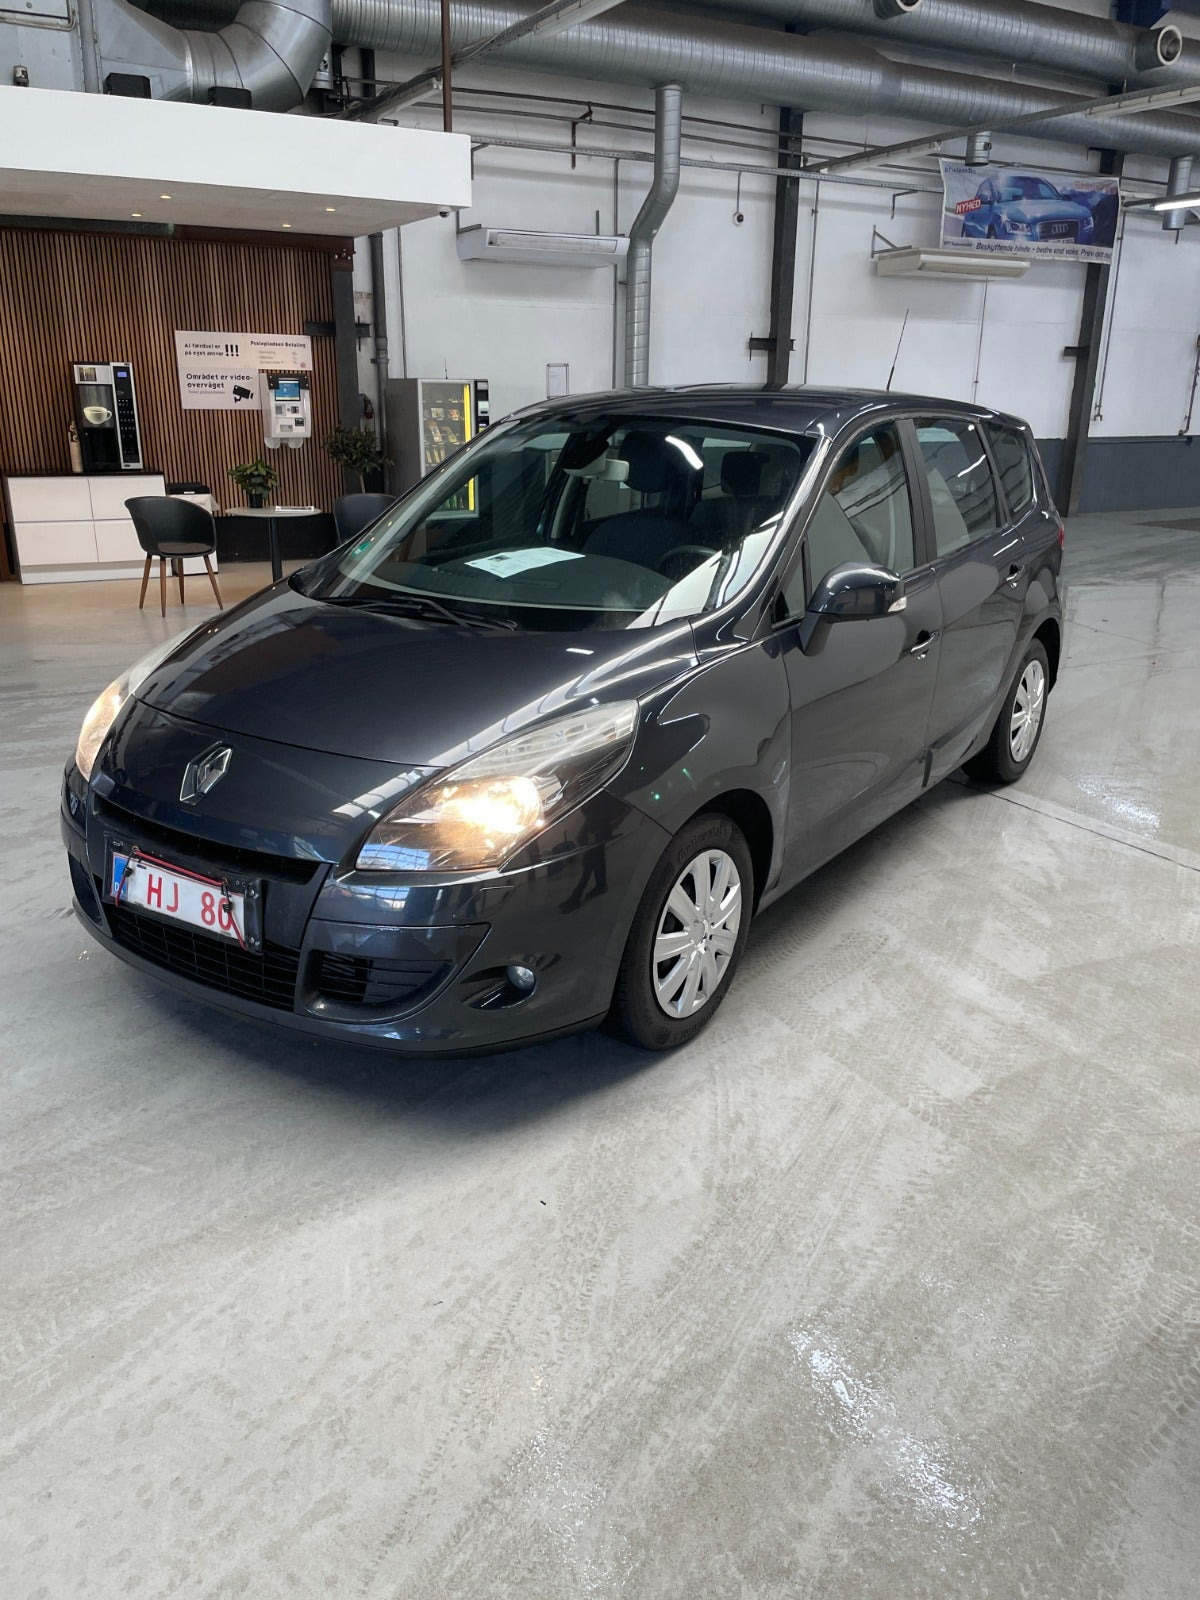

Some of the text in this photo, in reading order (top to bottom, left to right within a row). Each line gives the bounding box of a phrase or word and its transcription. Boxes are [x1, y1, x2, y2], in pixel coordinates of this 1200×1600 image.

[956, 200, 981, 213] NYHED
[976, 242, 1013, 252] Beskyttende
[1014, 244, 1030, 252] hinde
[187, 381, 225, 389] overvåget
[147, 873, 232, 931] HJ 80
